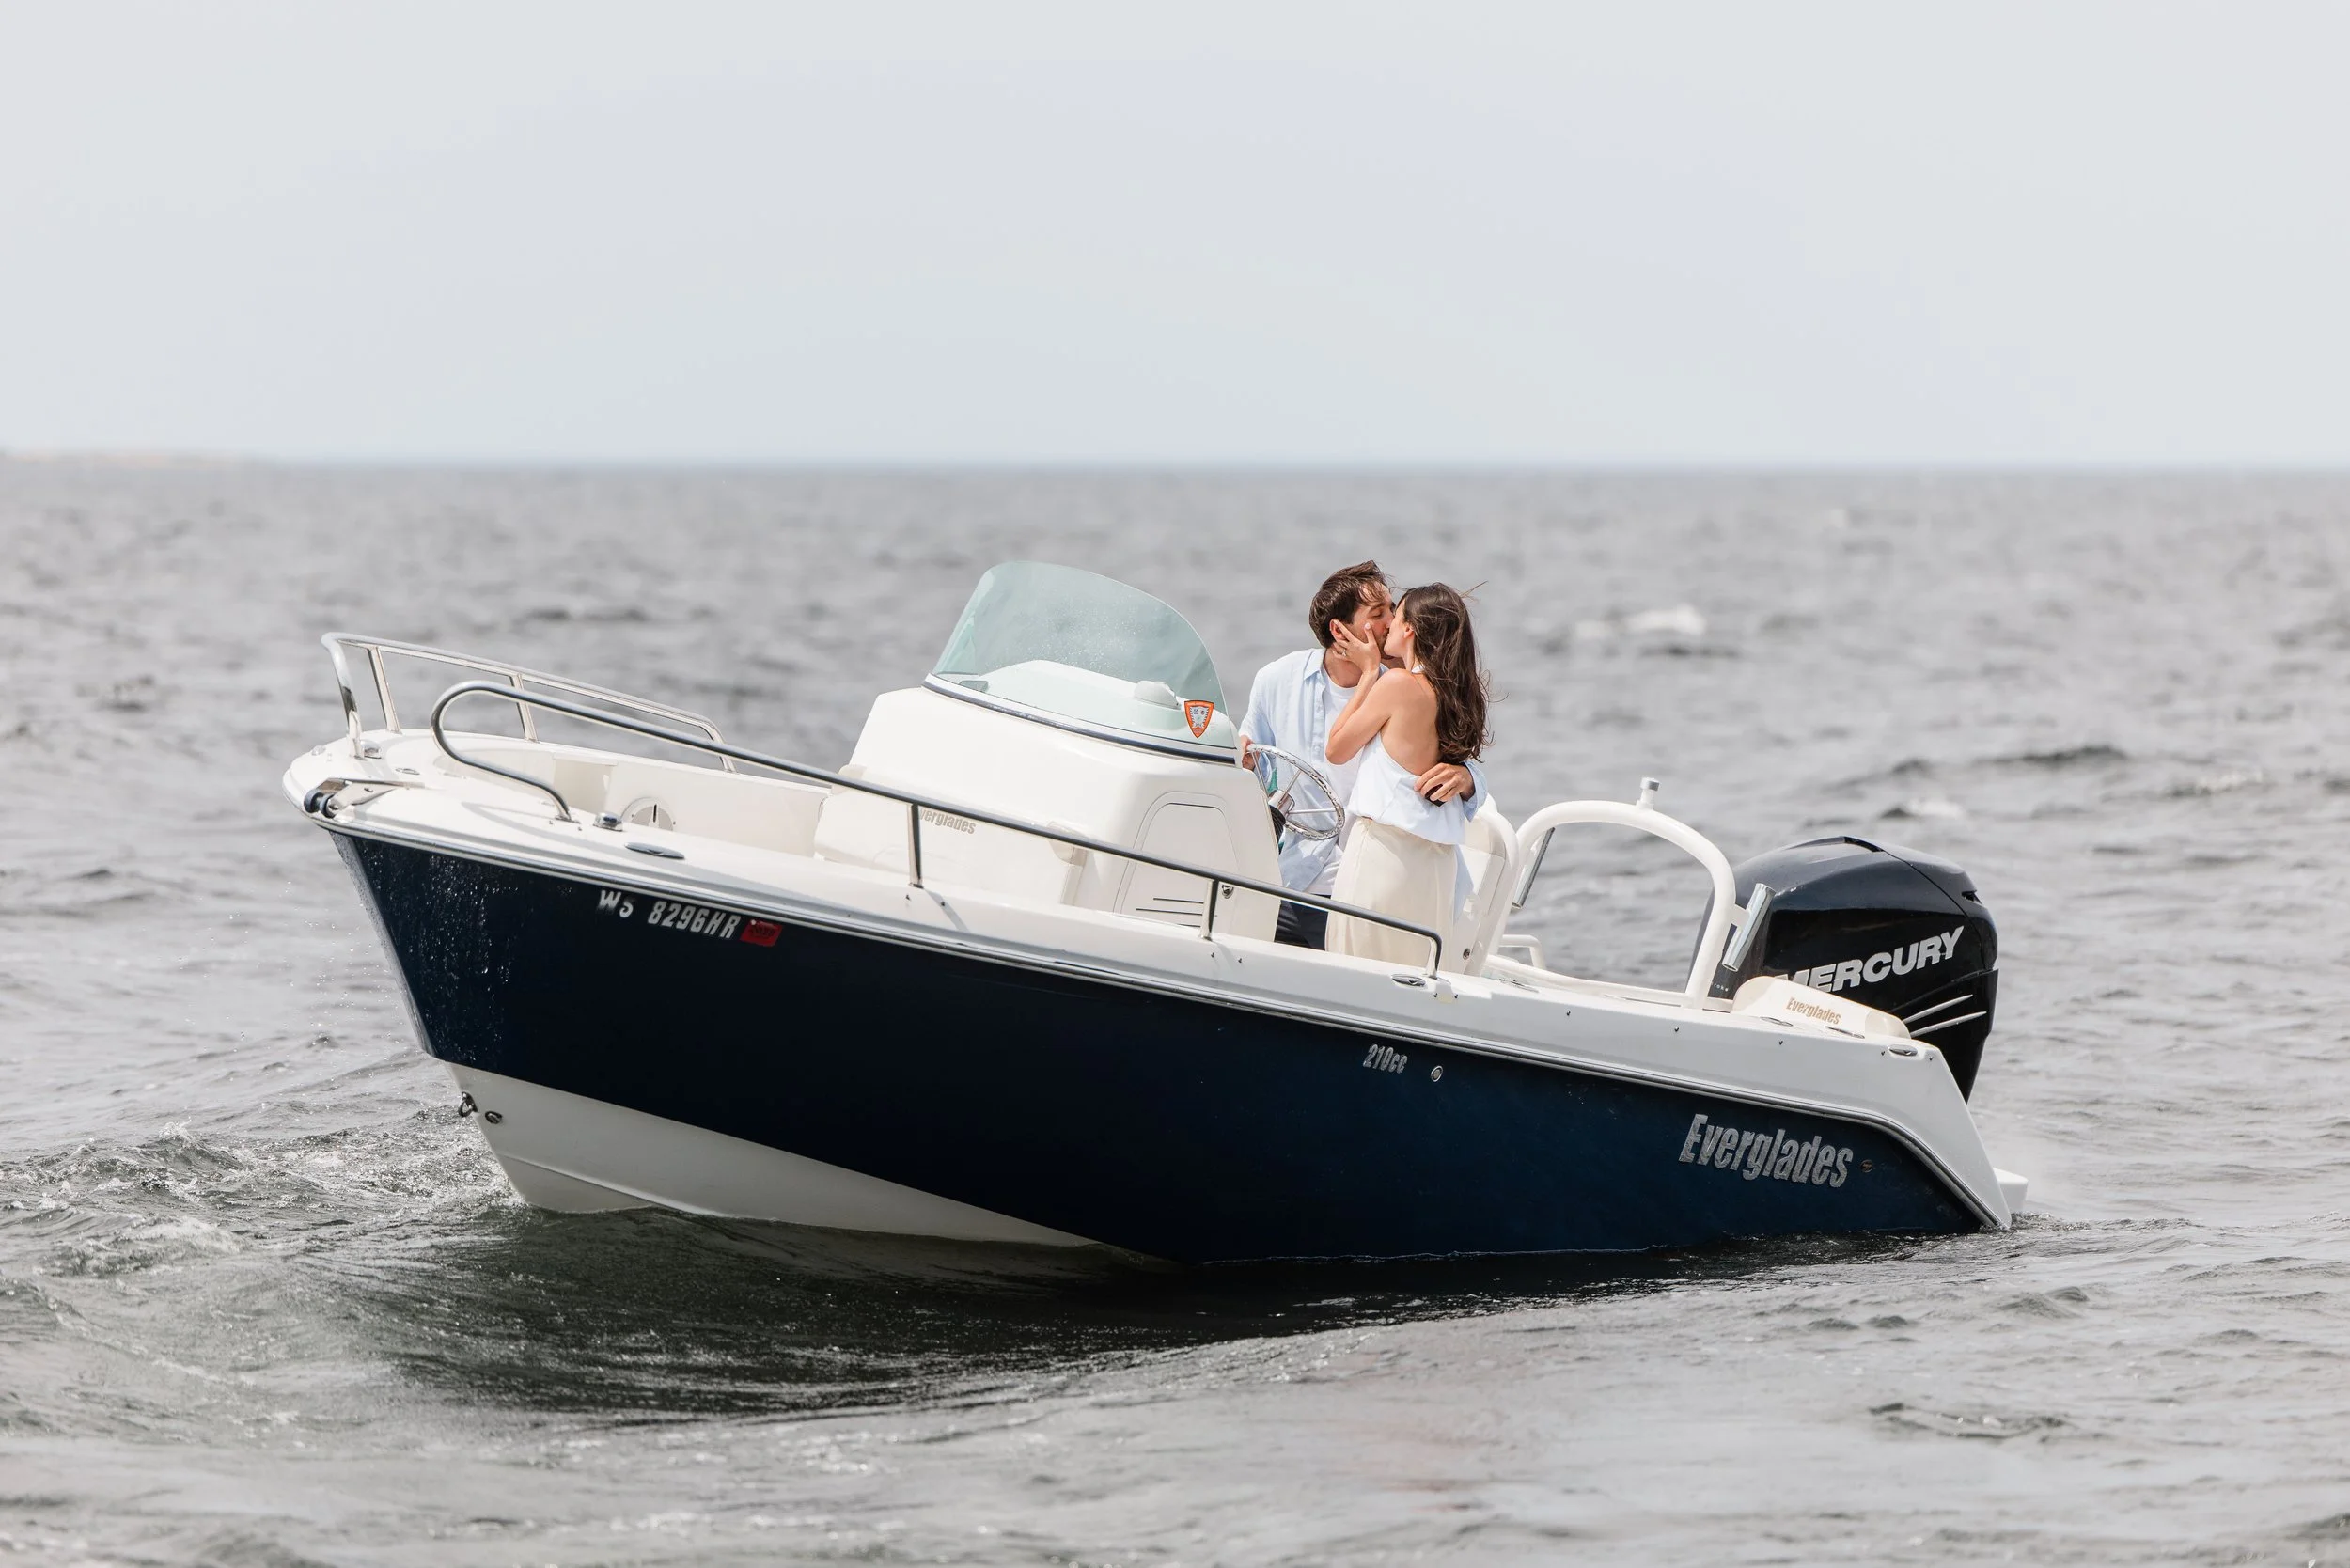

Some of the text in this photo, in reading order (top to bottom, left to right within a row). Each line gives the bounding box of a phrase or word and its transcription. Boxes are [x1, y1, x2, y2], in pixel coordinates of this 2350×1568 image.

[919, 808, 977, 835] verglades
[647, 901, 741, 939] 8296HR
[1786, 996, 1841, 1025] Everglades
[1363, 1043, 1408, 1074] 210cc
[1678, 1113, 1854, 1188] Everglades
